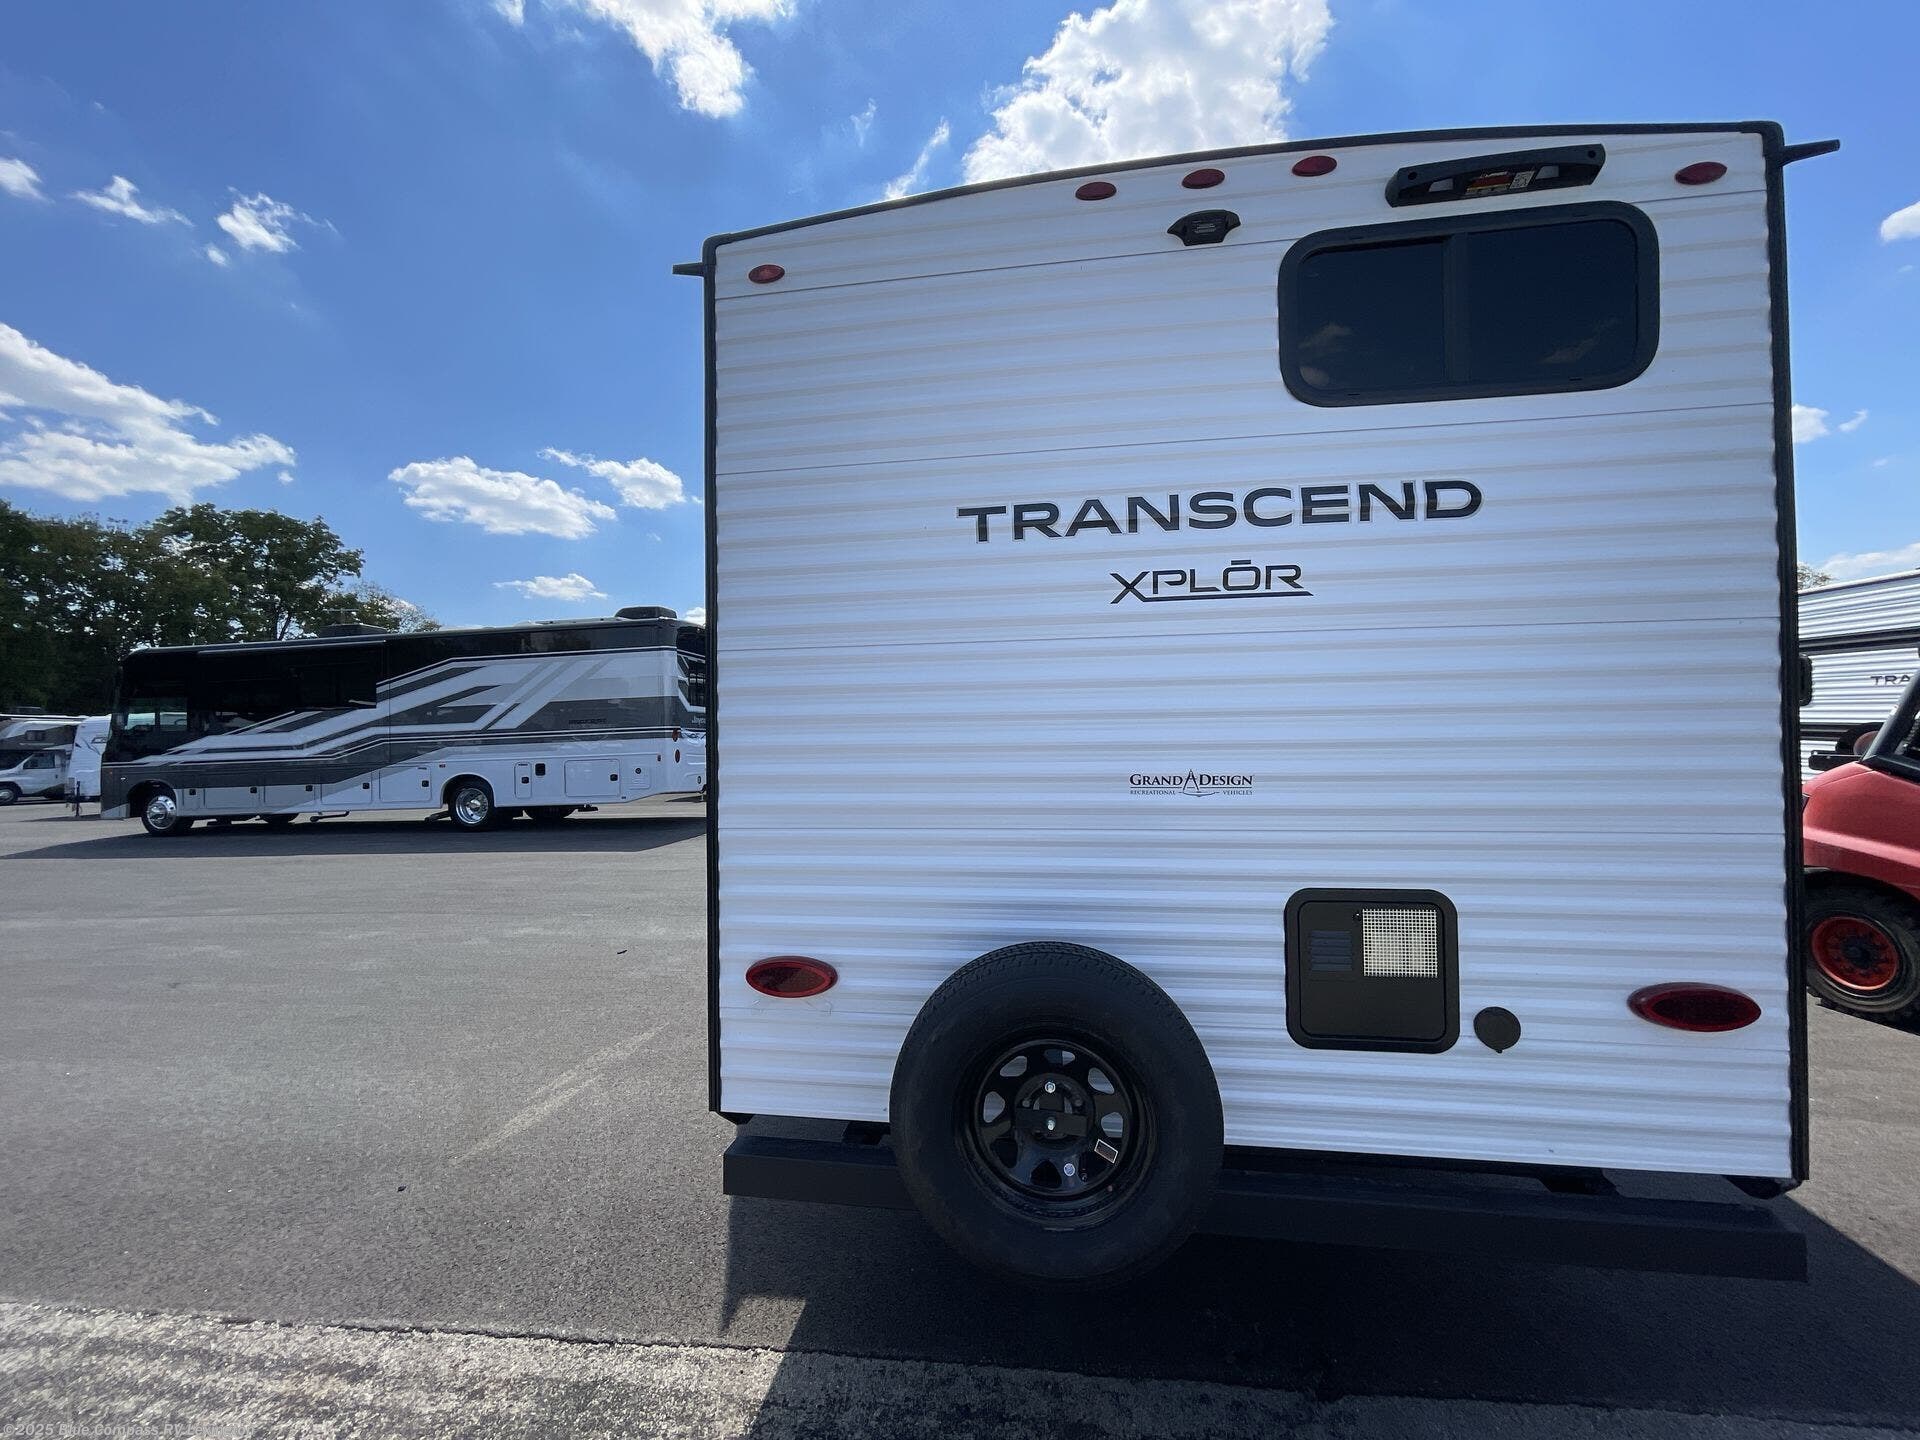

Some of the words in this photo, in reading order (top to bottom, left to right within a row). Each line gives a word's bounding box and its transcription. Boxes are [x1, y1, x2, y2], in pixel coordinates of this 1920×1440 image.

[957, 480, 1483, 543] TRANSCEND
[1129, 773, 1183, 786] GRAND
[1199, 773, 1253, 786] DESIGN
